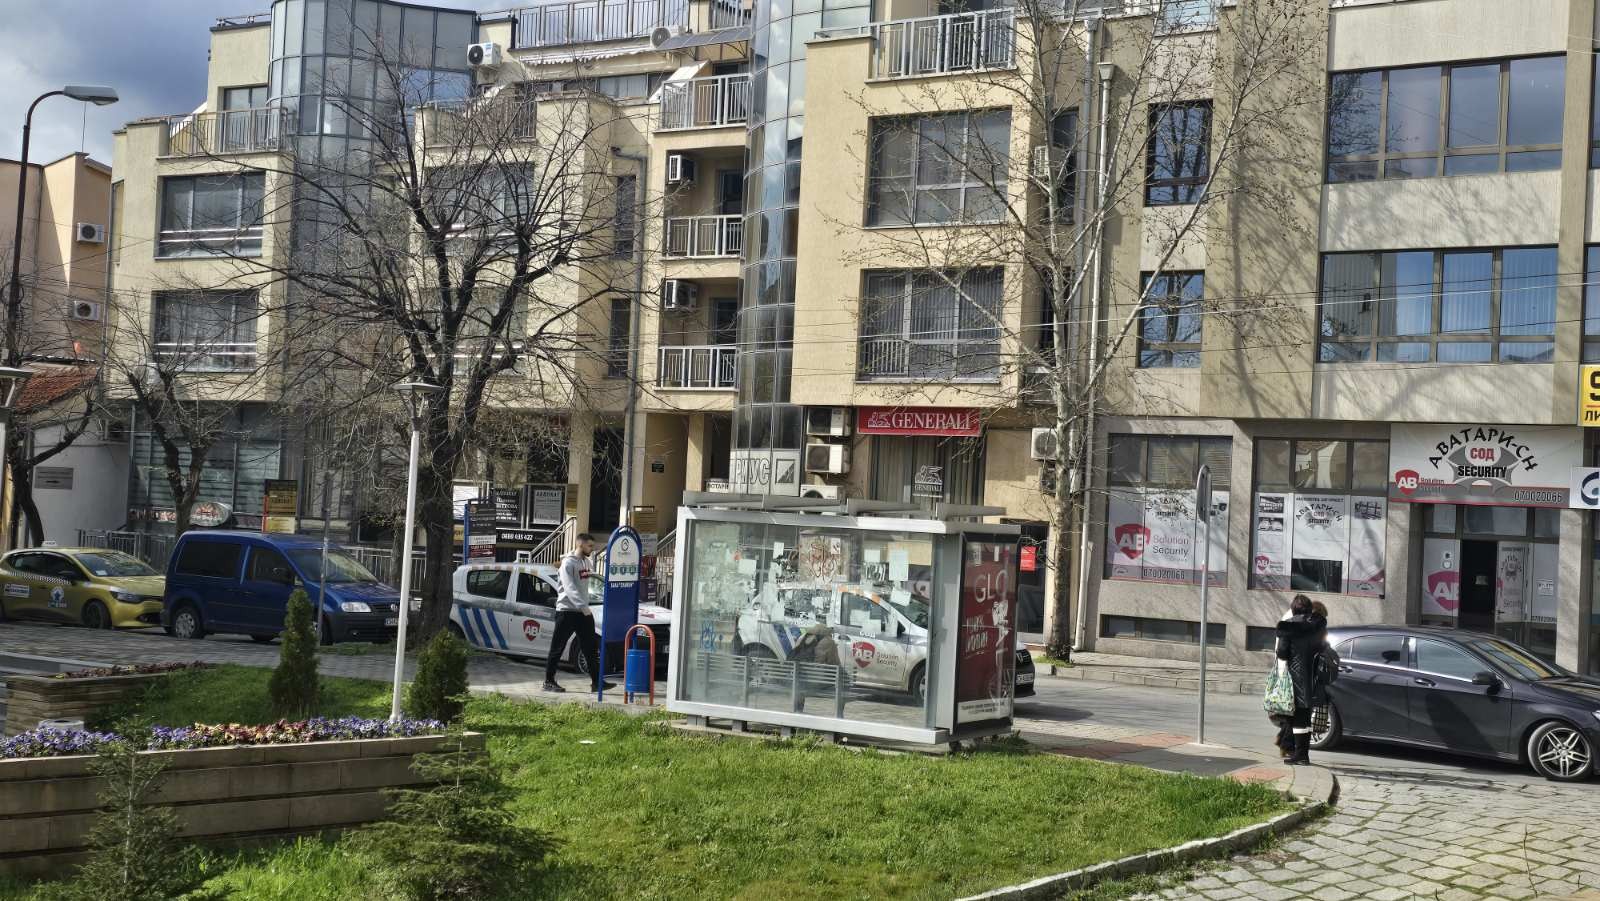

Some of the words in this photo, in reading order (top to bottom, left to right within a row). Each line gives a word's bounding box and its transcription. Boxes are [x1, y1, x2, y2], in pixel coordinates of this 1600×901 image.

[892, 412, 971, 430] GENERALI
[1429, 427, 1538, 471] АВАТАРИ-СН
[1470, 447, 1494, 461] СОД
[1458, 465, 1507, 478] SECURITY
[1398, 476, 1418, 489] AB
[1153, 534, 1188, 545] Solution
[1153, 546, 1188, 557] Security
